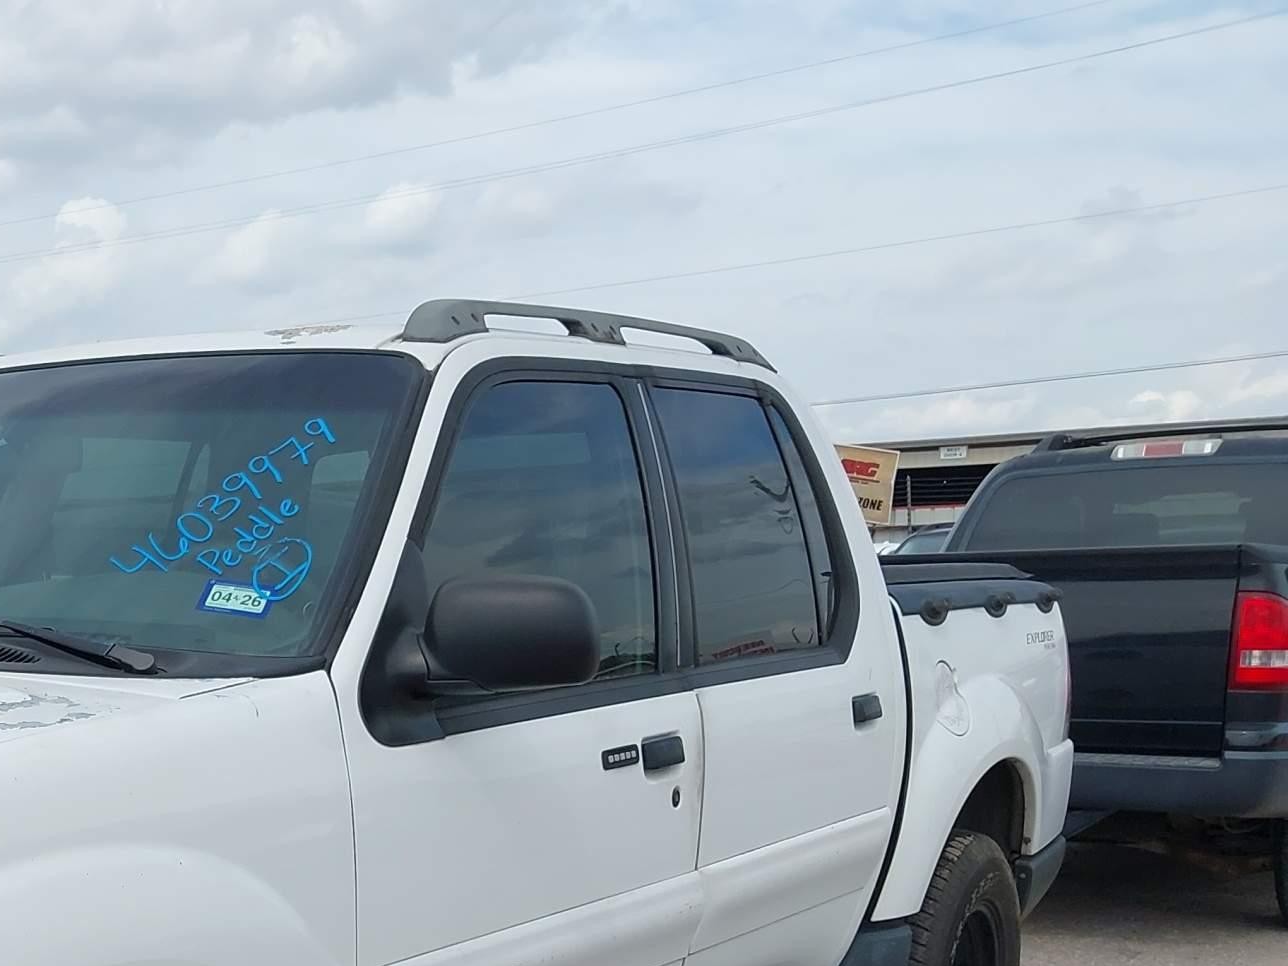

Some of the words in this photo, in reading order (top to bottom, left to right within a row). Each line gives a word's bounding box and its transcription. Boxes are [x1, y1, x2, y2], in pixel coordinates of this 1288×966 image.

[109, 416, 336, 574] 46039979
[196, 496, 300, 575] Peddle
[210, 590, 233, 604] 04
[239, 594, 263, 608] 26
[1026, 630, 1055, 645] EXPLORER
